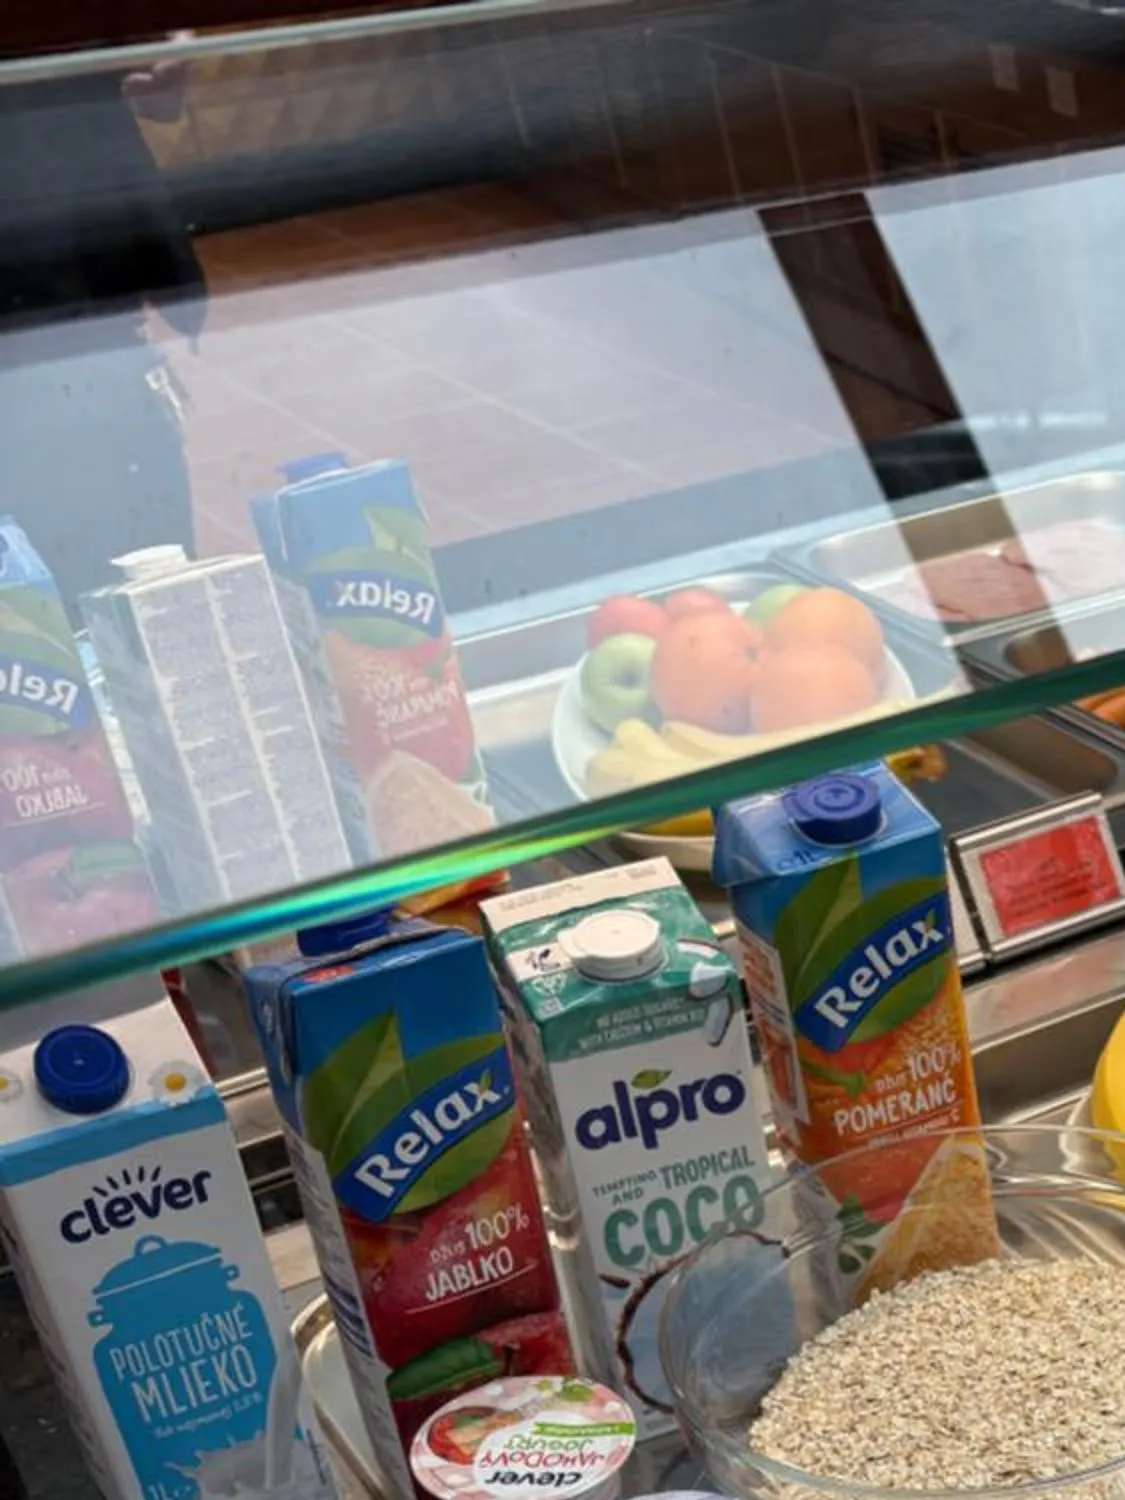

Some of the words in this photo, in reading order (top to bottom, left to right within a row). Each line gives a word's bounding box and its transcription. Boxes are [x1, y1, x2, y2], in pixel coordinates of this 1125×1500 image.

[814, 918, 944, 1028] Relax
[906, 1042, 960, 1081] 100%
[354, 1078, 501, 1198] Relax
[575, 1073, 746, 1150] alpro
[833, 1070, 957, 1136] POMERANČ
[658, 1145, 756, 1190] TROPICAL
[60, 1169, 212, 1244] clever
[465, 1203, 529, 1250] 100%
[603, 1174, 765, 1268] COCO
[425, 1246, 514, 1301] JABLKO
[109, 1302, 253, 1381] POLOTUČNÉ
[131, 1345, 257, 1423] MLIEKO
[485, 1471, 582, 1486] clever
